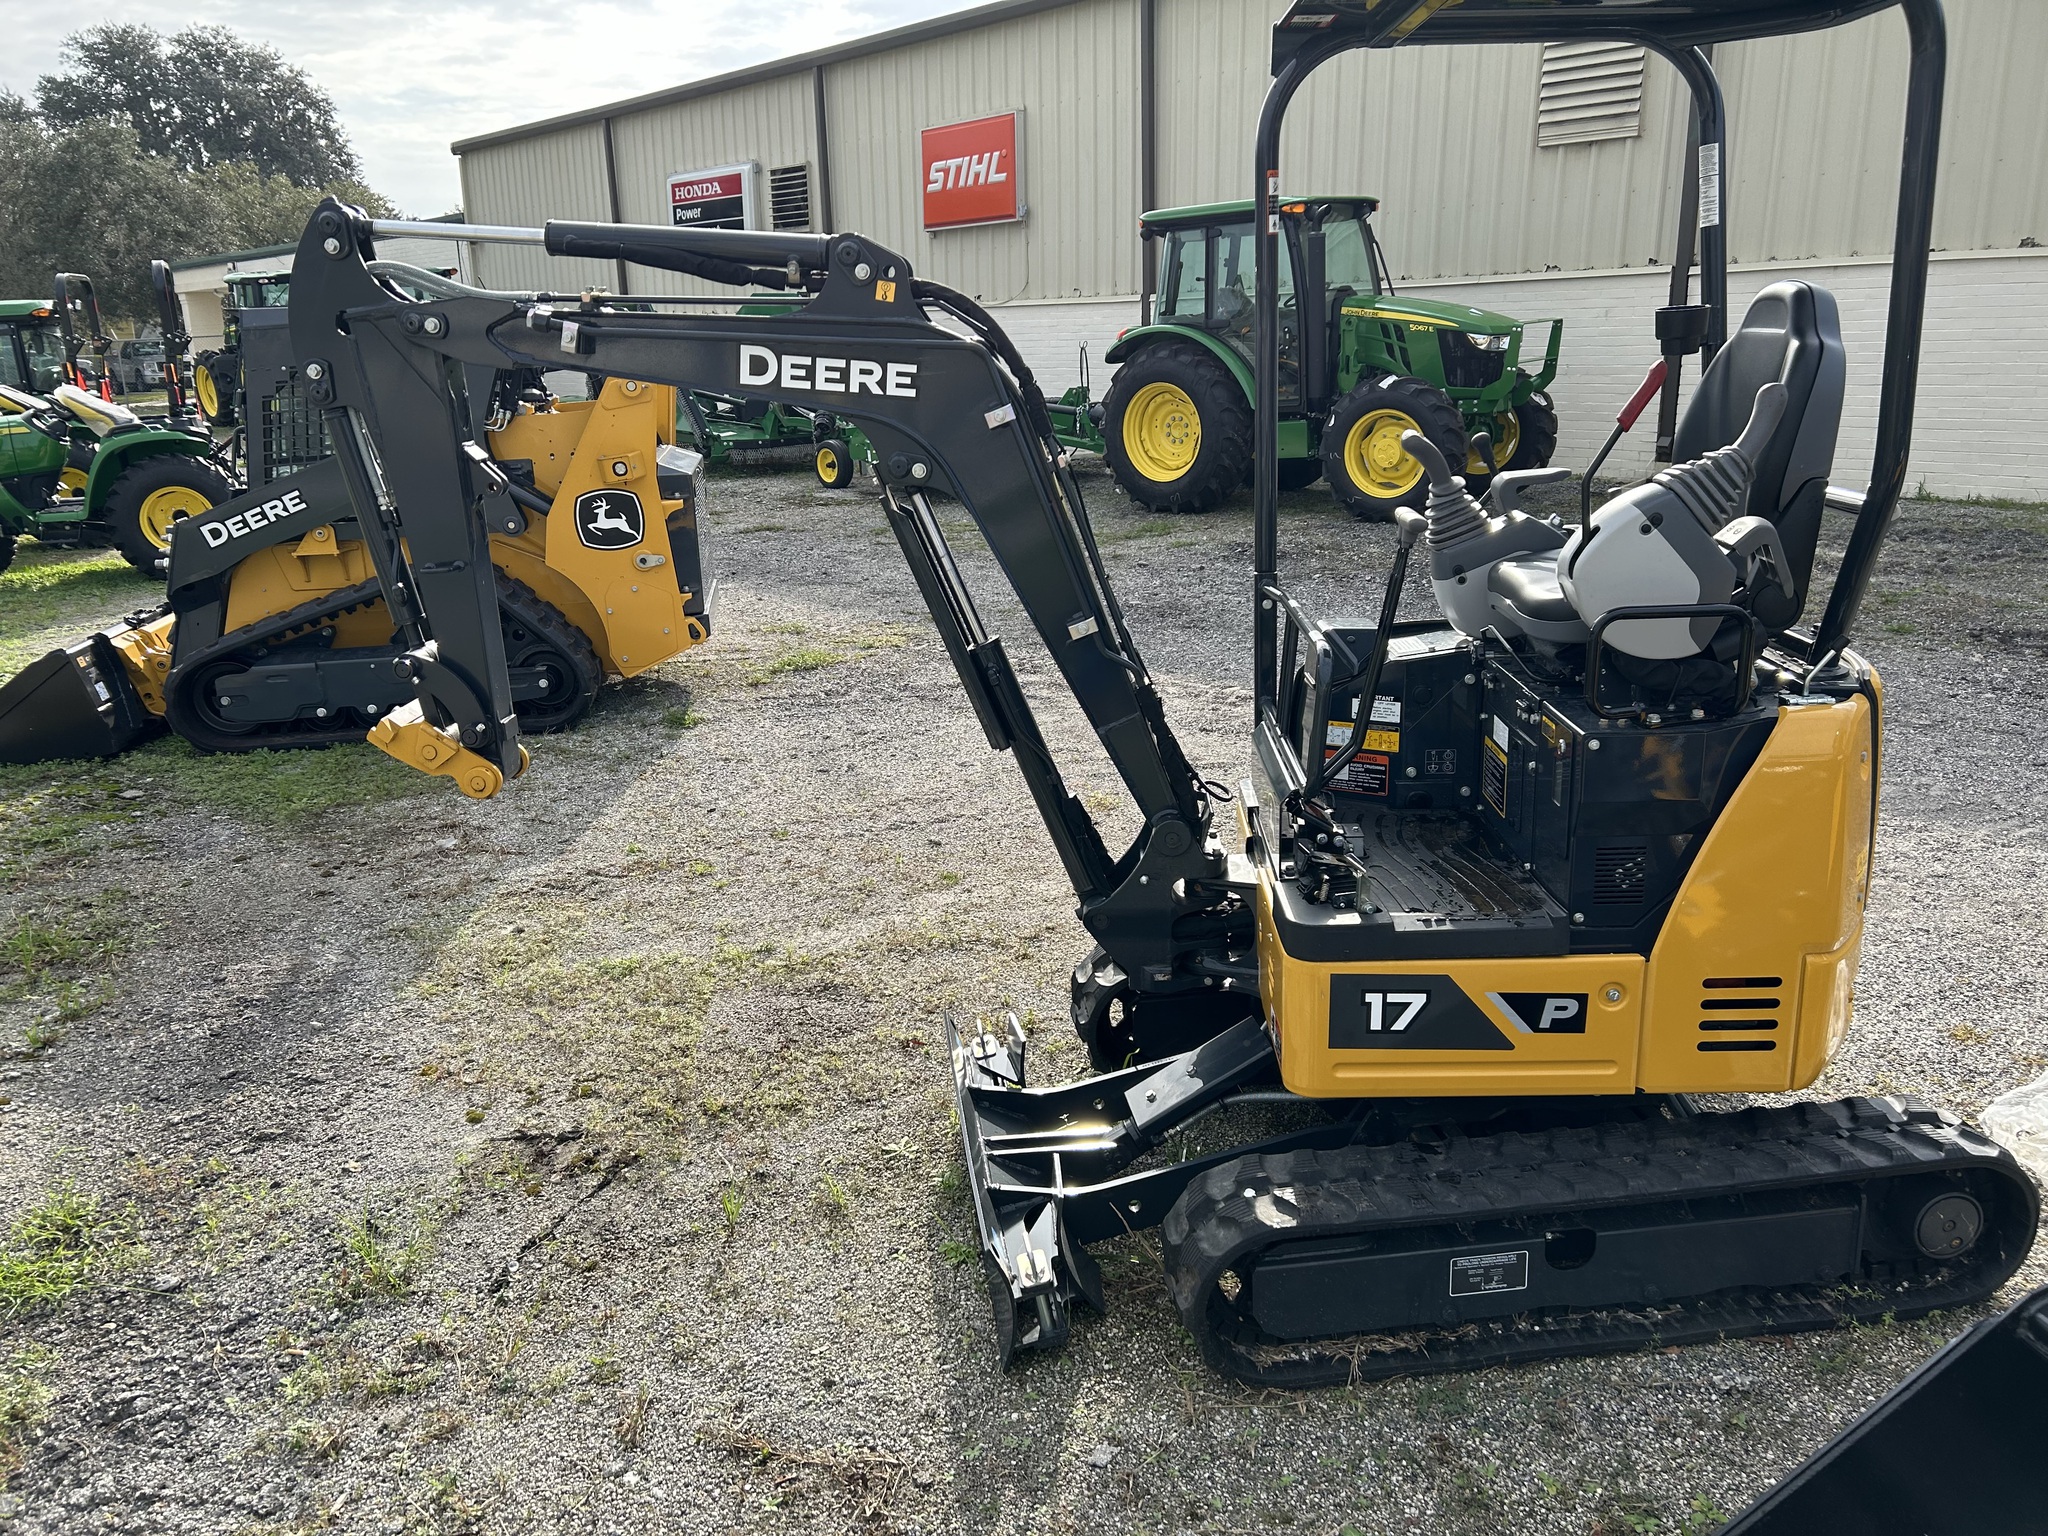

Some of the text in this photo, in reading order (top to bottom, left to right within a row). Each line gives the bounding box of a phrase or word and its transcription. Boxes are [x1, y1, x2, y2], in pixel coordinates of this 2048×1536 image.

[926, 151, 1008, 193] STIHL
[674, 182, 722, 200] HONDA
[676, 207, 702, 221] Power
[1345, 308, 1380, 317] JOHN DEERE
[1409, 323, 1428, 331] 5067
[739, 344, 918, 397] DEERE
[199, 489, 308, 548] DEERE
[1358, 693, 1395, 702] IRTANT
[1364, 992, 1427, 1031] 17
[1538, 998, 1579, 1029] P
